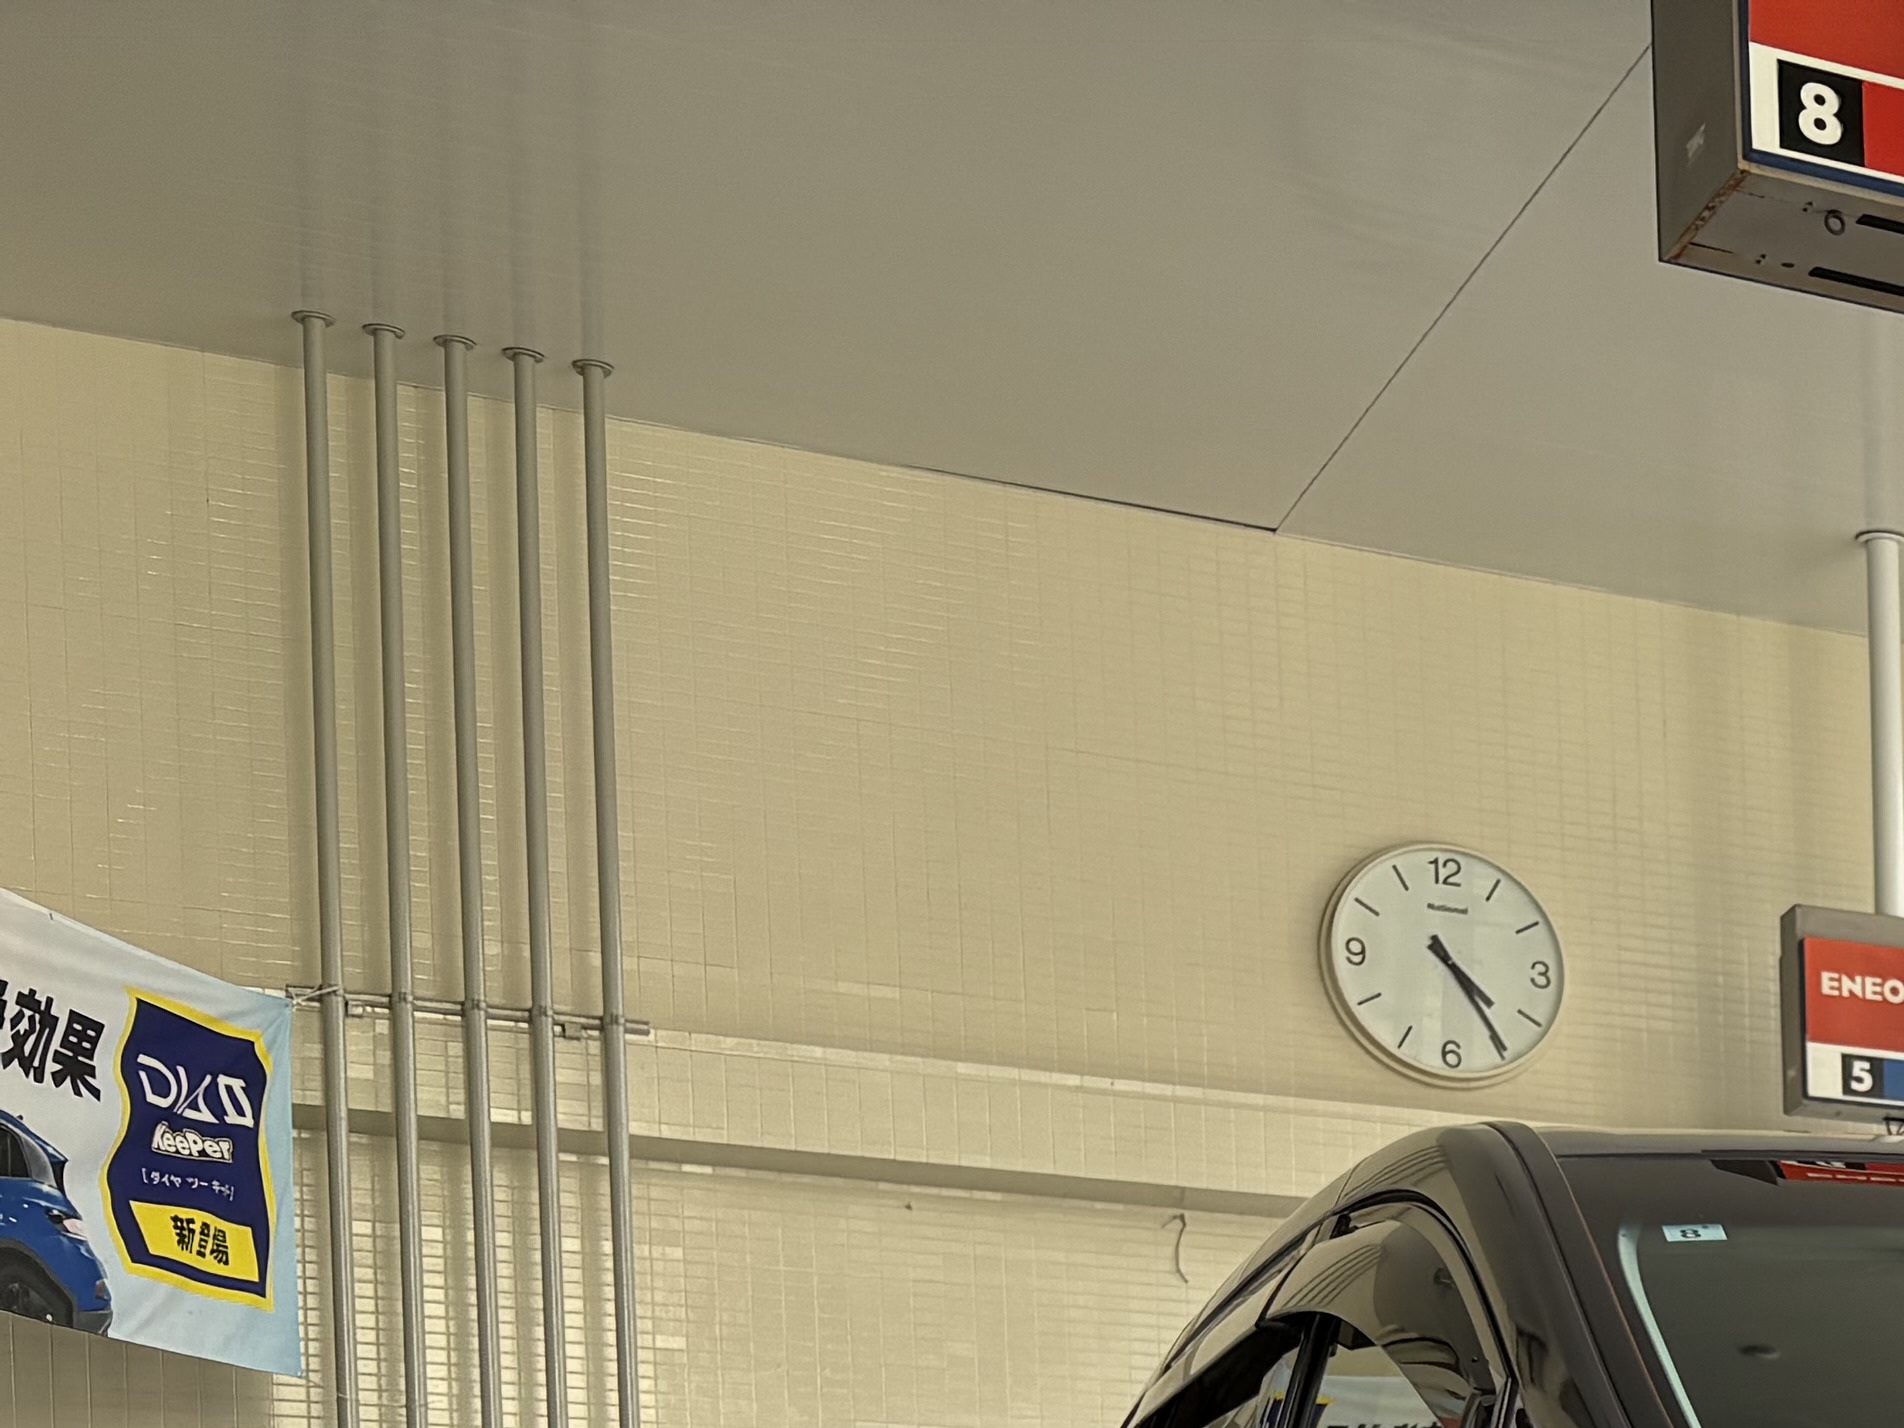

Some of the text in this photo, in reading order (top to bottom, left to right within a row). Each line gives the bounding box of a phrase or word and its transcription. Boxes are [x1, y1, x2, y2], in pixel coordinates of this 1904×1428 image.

[1798, 79, 1844, 147] 8
[1427, 857, 1462, 887] 12
[1344, 937, 1366, 966] 9
[1530, 961, 1551, 989] 3
[1441, 1040, 1462, 1069] 6
[1849, 1060, 1873, 1092] 5
[151, 1121, 235, 1164] KeePer
